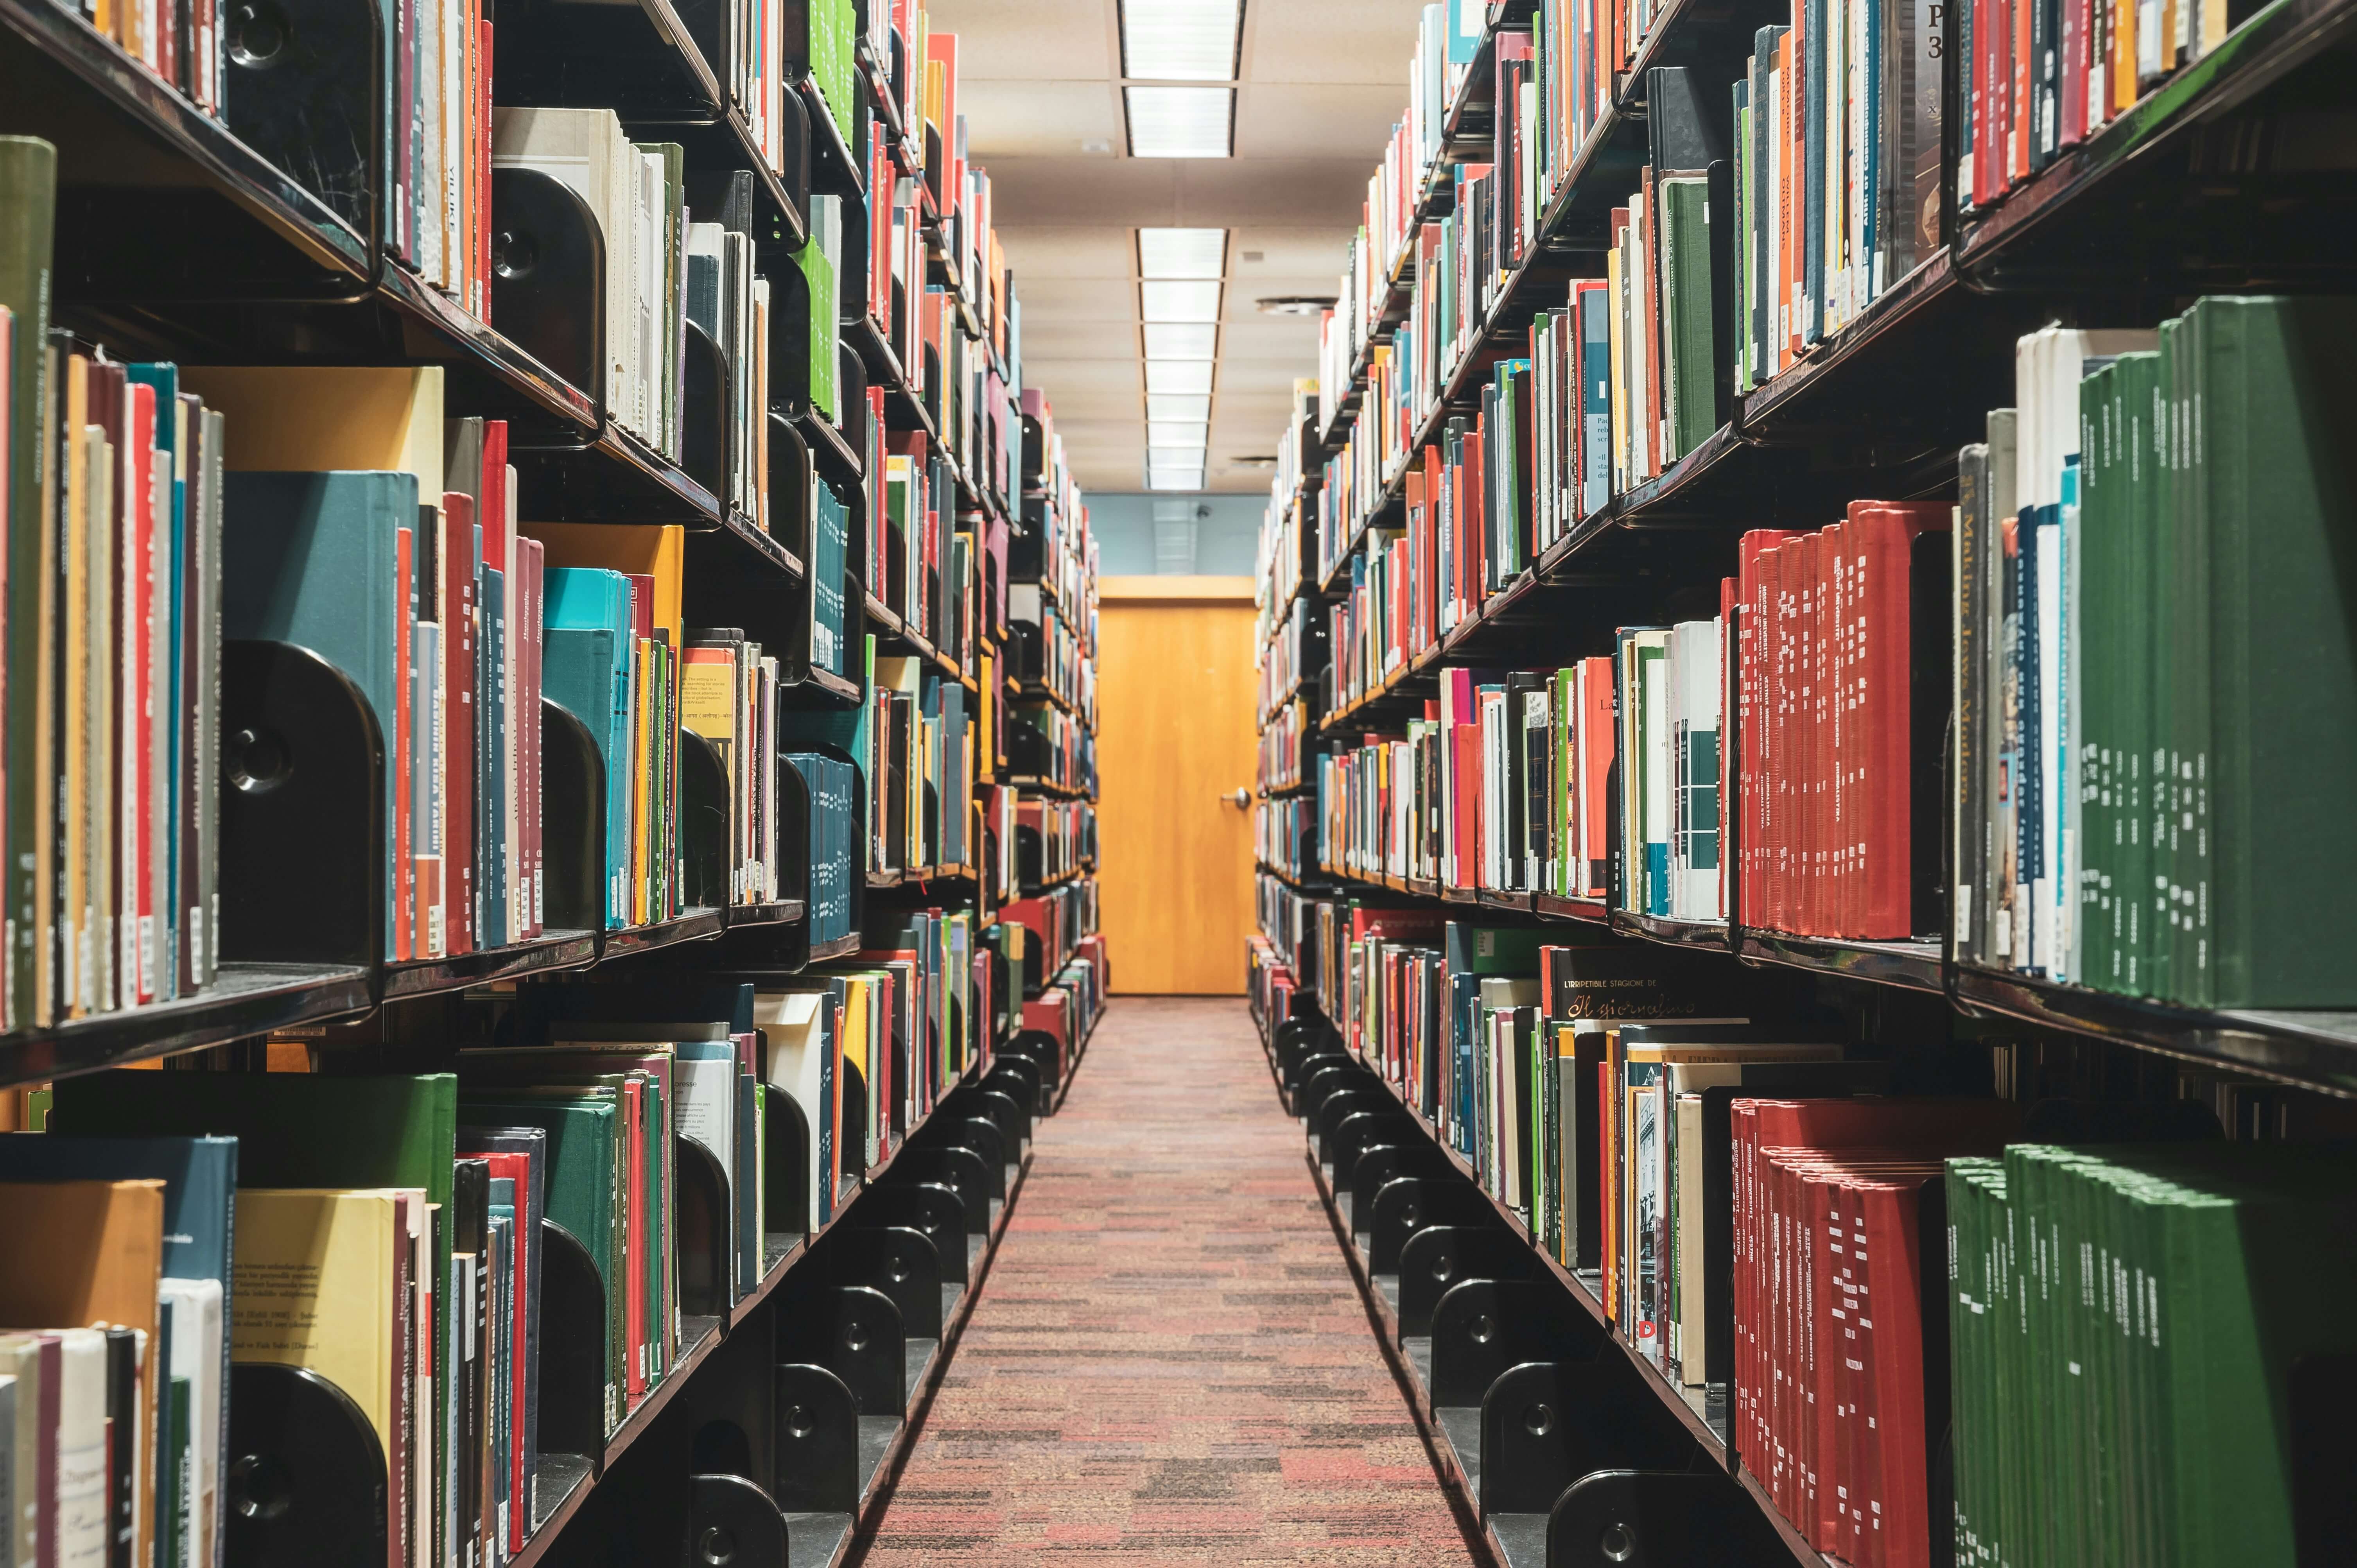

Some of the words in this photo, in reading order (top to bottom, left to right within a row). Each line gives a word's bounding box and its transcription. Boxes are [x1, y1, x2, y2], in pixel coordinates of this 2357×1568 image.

[1961, 513, 1974, 617] Making
[1962, 625, 1972, 690] Jews
[1961, 699, 1971, 803] Modern
[1564, 980, 1606, 988] L'IRRIPETIBILE
[1568, 995, 1593, 1018] Il
[1596, 992, 1695, 1020] giornalino
